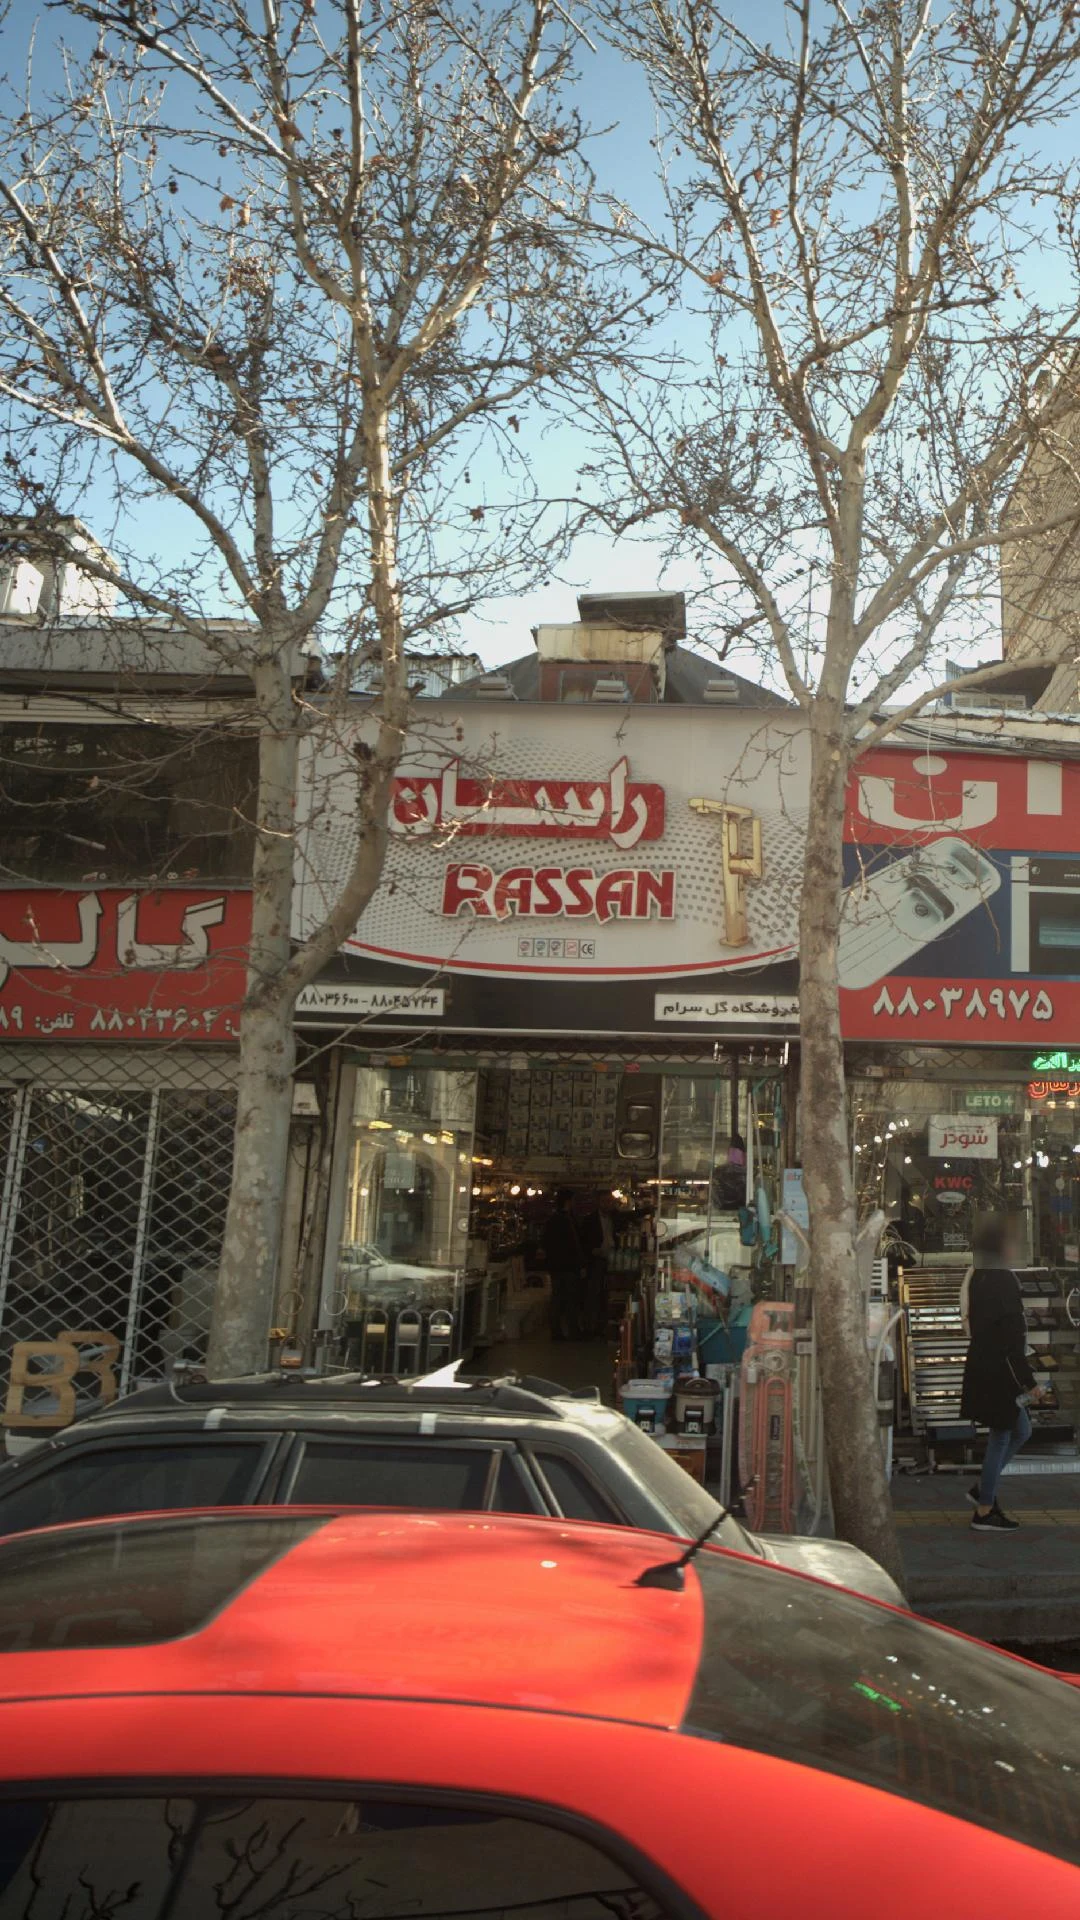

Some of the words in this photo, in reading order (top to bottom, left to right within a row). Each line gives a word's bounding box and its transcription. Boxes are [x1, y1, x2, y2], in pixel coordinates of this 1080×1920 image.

[388, 755, 649, 850] راسان
[442, 863, 675, 926] RASSAN
[873, 985, 1053, 1020] ۸۸۰۳۸۹۷۵
[934, 1176, 973, 1189] KWC
